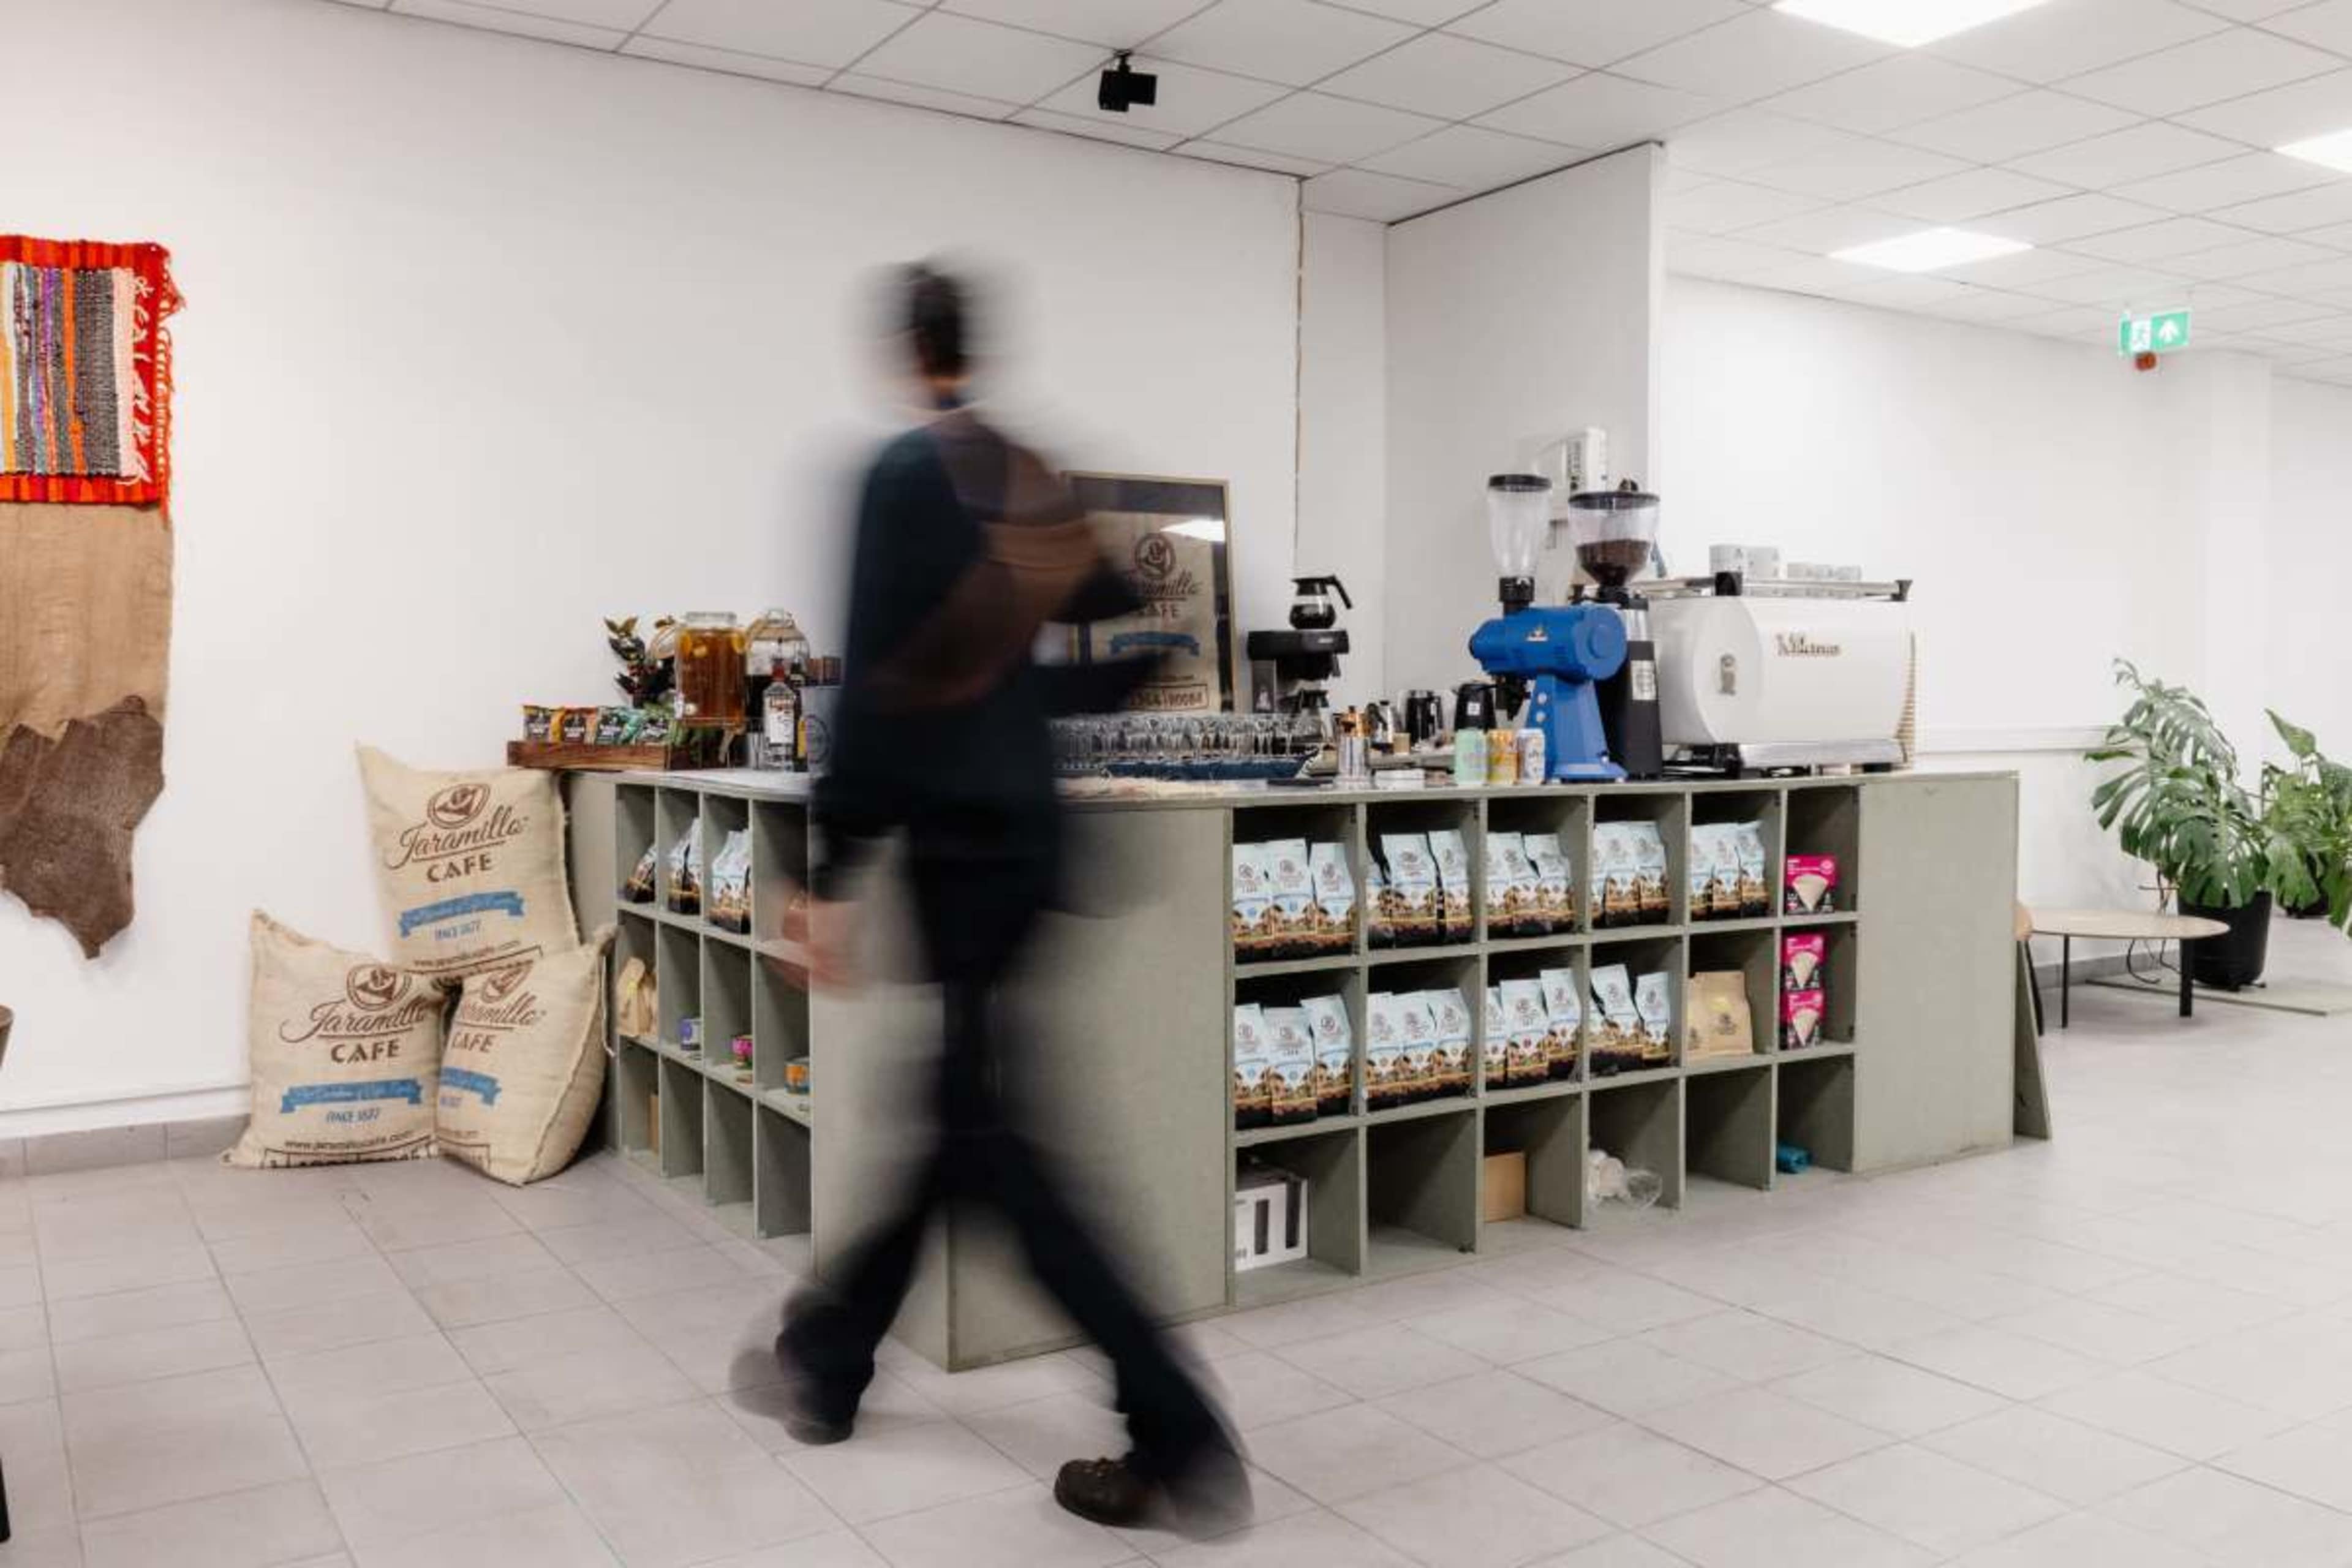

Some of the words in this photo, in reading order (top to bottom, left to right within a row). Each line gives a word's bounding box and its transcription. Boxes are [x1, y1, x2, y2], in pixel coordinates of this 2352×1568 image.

[385, 805, 525, 870] Jaramillo
[427, 854, 492, 882] CAFE
[331, 1038, 400, 1063] CAFE
